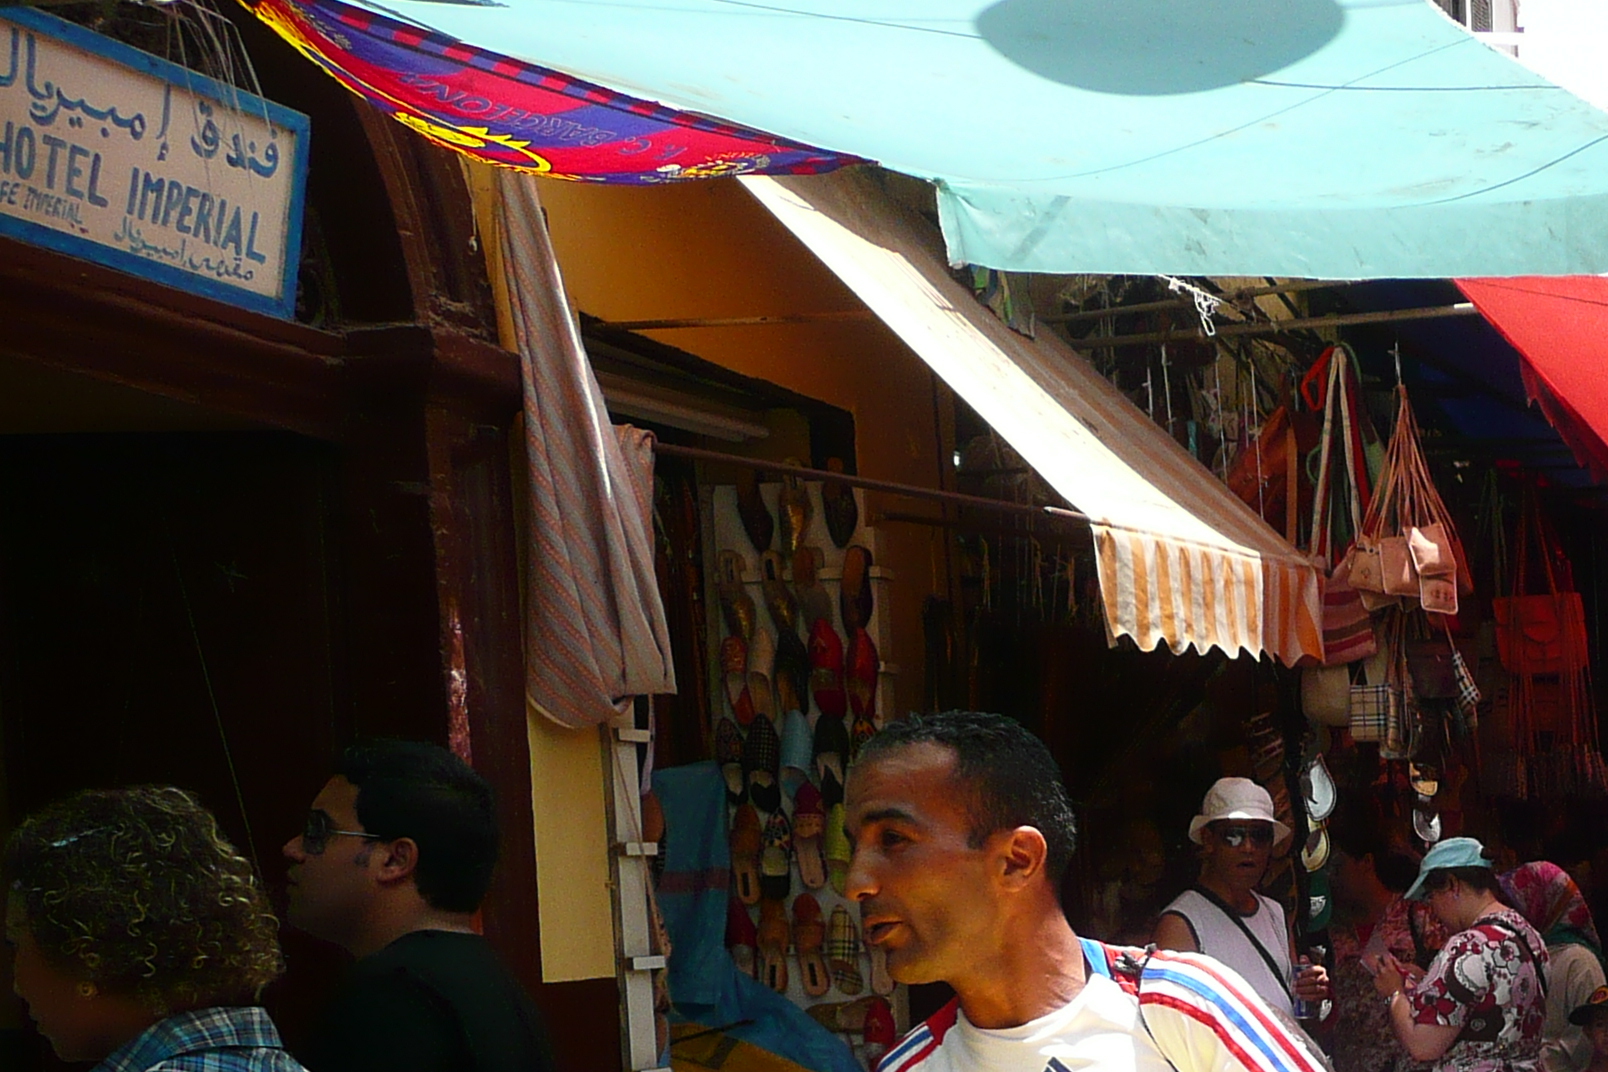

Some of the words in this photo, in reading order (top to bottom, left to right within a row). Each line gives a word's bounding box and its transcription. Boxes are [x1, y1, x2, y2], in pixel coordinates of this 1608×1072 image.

[191, 100, 280, 179] فندق
[402, 71, 618, 148] BARCELONA
[0, 121, 108, 207] HOTEL
[127, 167, 267, 265] IMPERIAL
